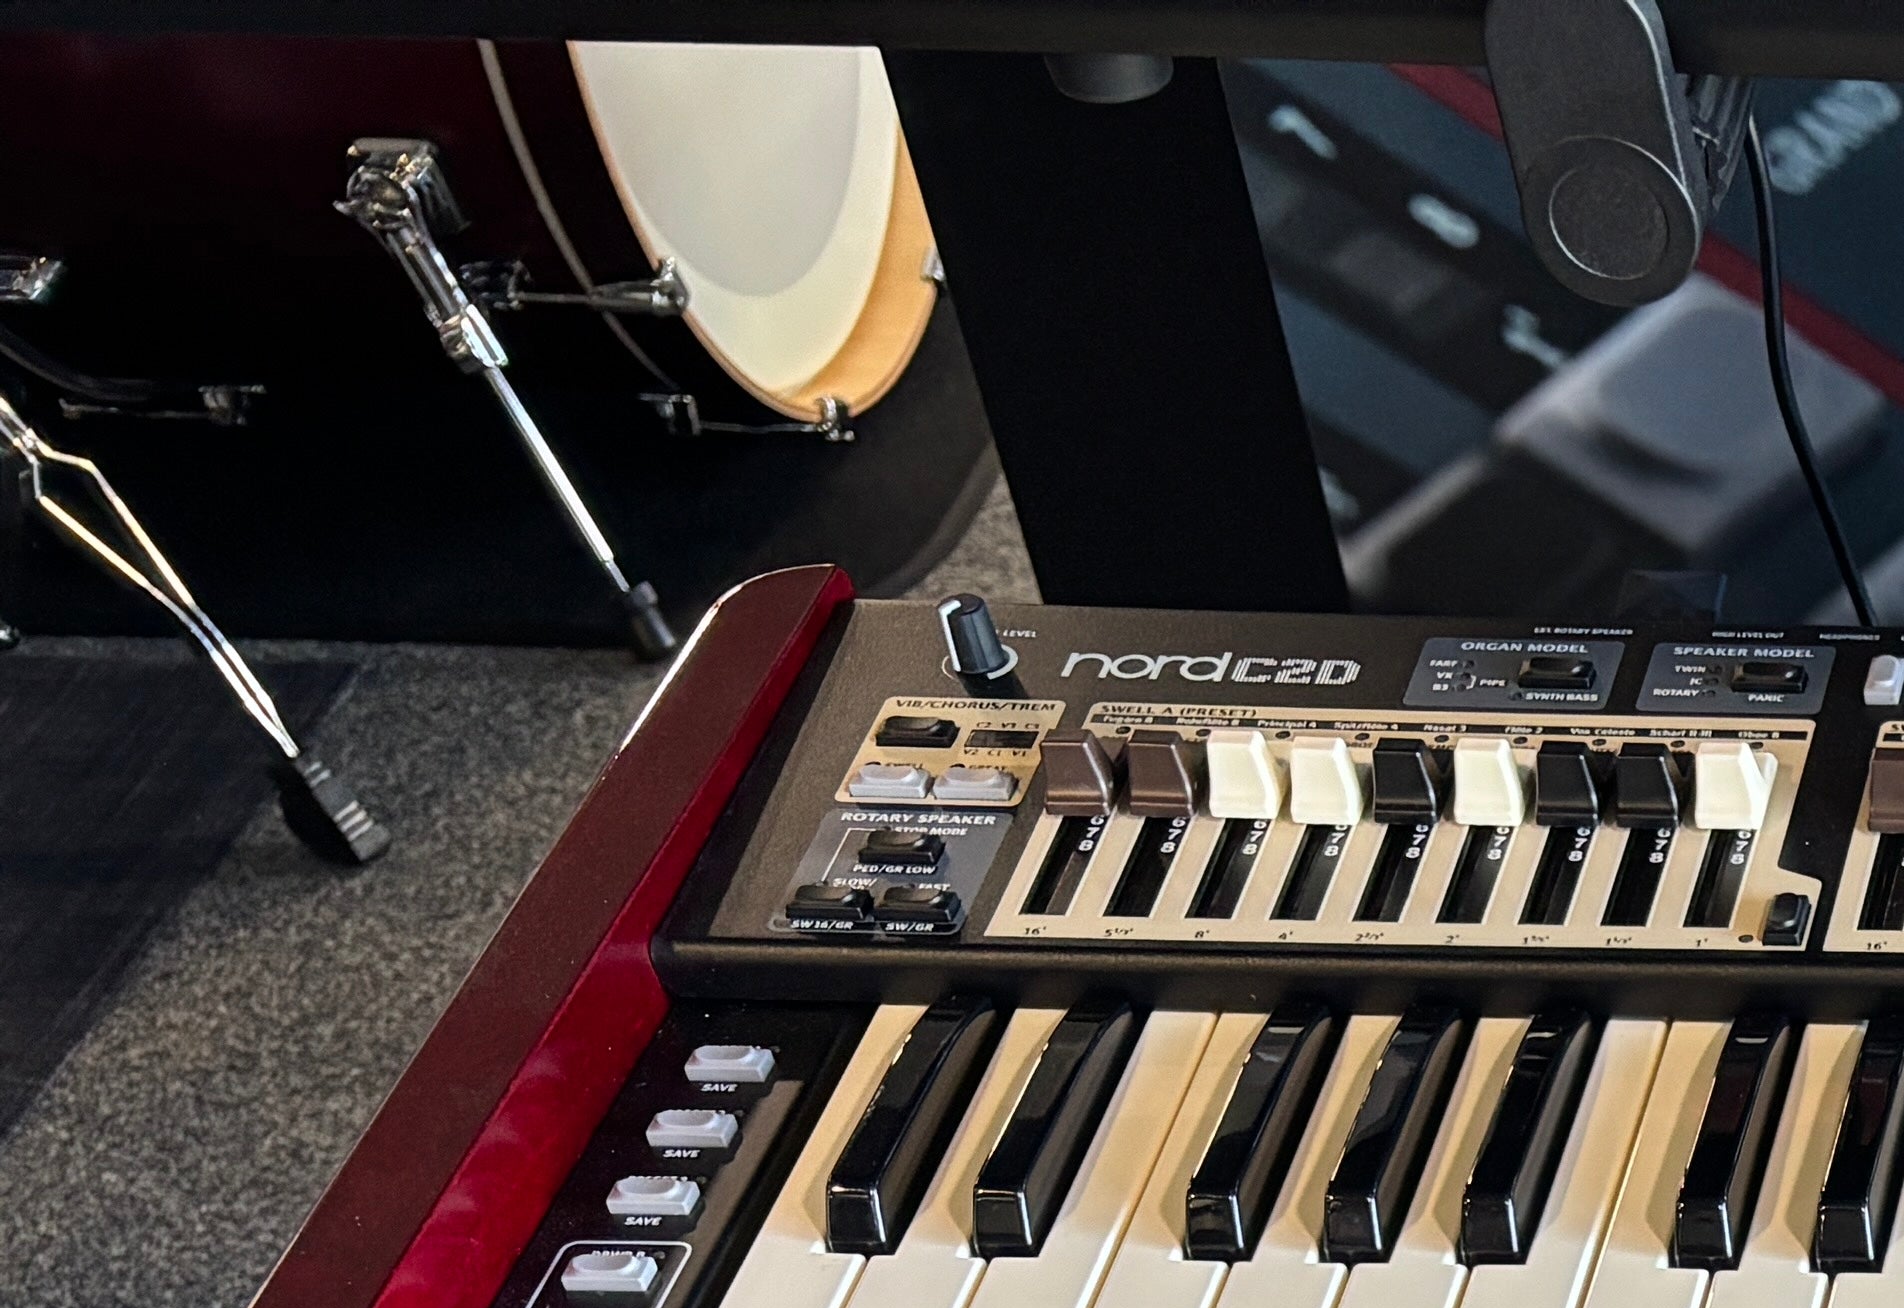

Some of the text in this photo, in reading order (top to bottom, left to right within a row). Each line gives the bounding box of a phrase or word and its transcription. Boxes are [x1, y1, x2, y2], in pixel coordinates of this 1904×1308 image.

[1002, 629, 1037, 638] LEVEL
[1461, 642, 1588, 654] ORGAN MODEL
[1673, 647, 1815, 658] SPEAKER MODEL
[1061, 652, 1361, 685] nord C2D
[1675, 665, 1706, 673] TWIN
[1479, 679, 1507, 687] PIPE
[1525, 692, 1598, 702] SYNTH BASS
[1653, 688, 1699, 697] ROTARY
[1748, 694, 1784, 702] PANIC
[896, 700, 1056, 712] VIB/CHORUS/TREM
[1102, 705, 1256, 717] SWELL A (PRESET)
[1257, 719, 1307, 730] Principal
[841, 812, 996, 825] ROTARY SPEAKER
[930, 827, 968, 836] MODE
[1086, 827, 1099, 838] 7
[1079, 839, 1093, 852] 8
[853, 864, 936, 875] PED/GR LOW
[885, 922, 934, 932] SW/GR
[701, 1083, 737, 1093] SAVE
[662, 1149, 700, 1158] SAVE
[624, 1216, 662, 1226] SAVE
